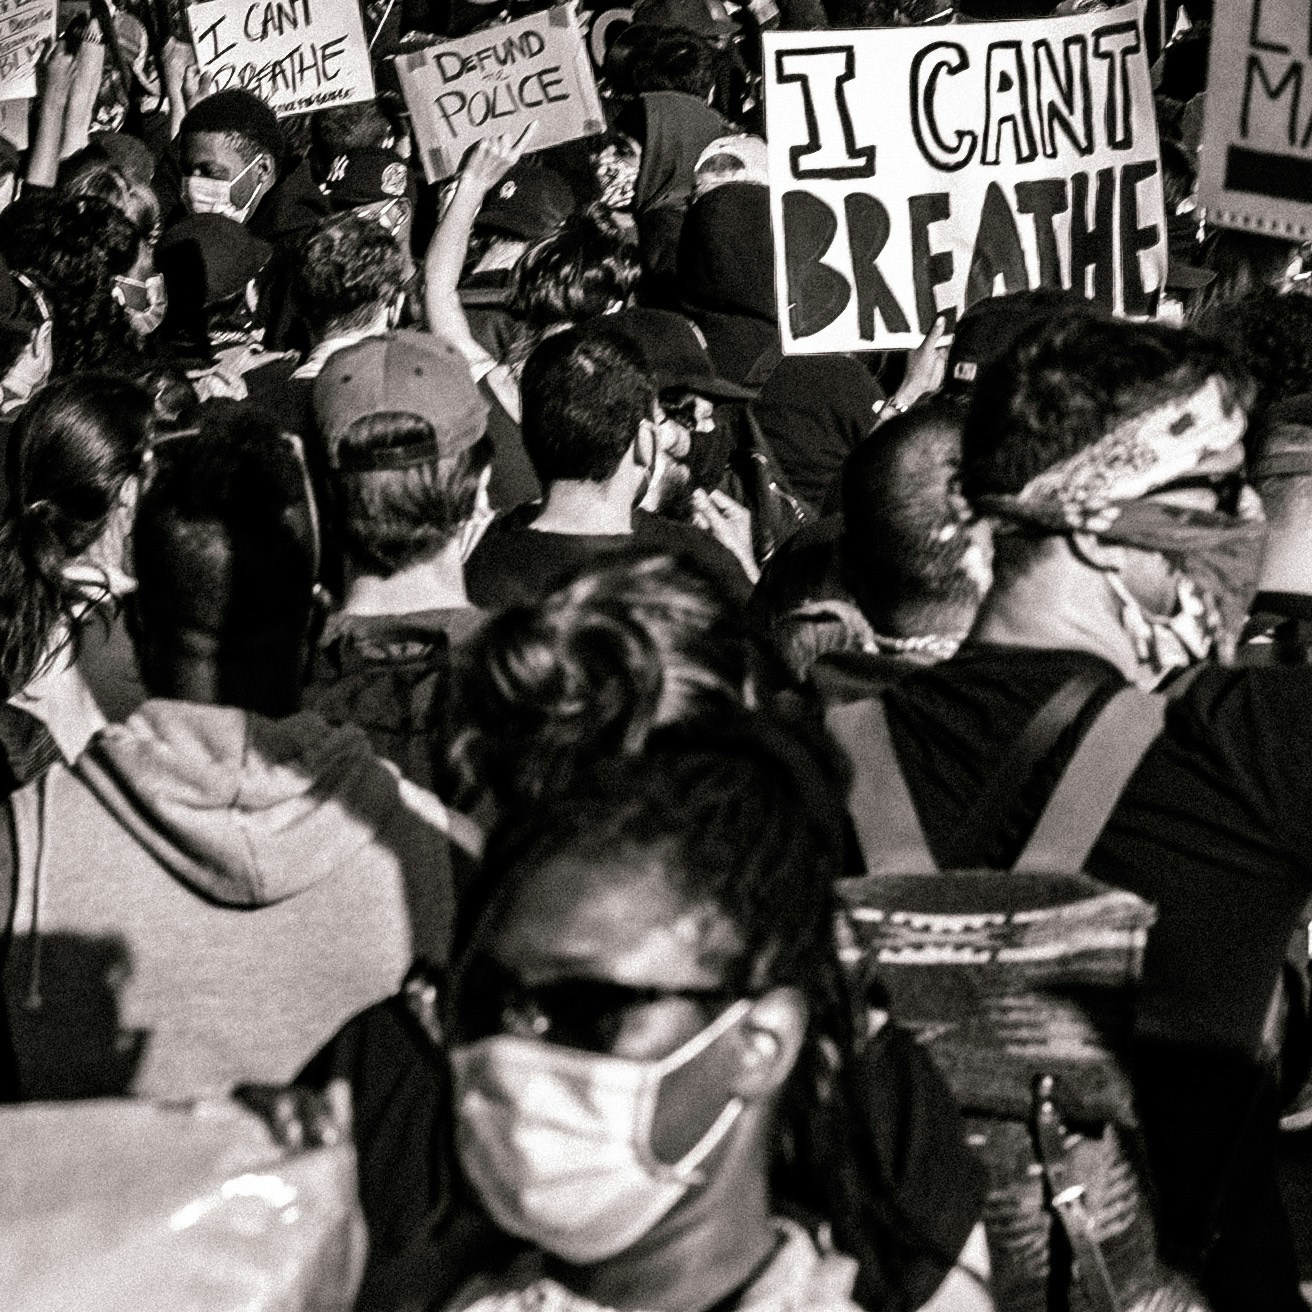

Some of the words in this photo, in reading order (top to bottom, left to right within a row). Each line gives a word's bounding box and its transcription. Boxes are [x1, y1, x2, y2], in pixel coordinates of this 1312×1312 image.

[197, 14, 239, 67] I
[435, 65, 571, 138] POLICE
[774, 44, 878, 180] I
[909, 19, 1143, 174] CANT
[781, 159, 1167, 342] BREATHE
